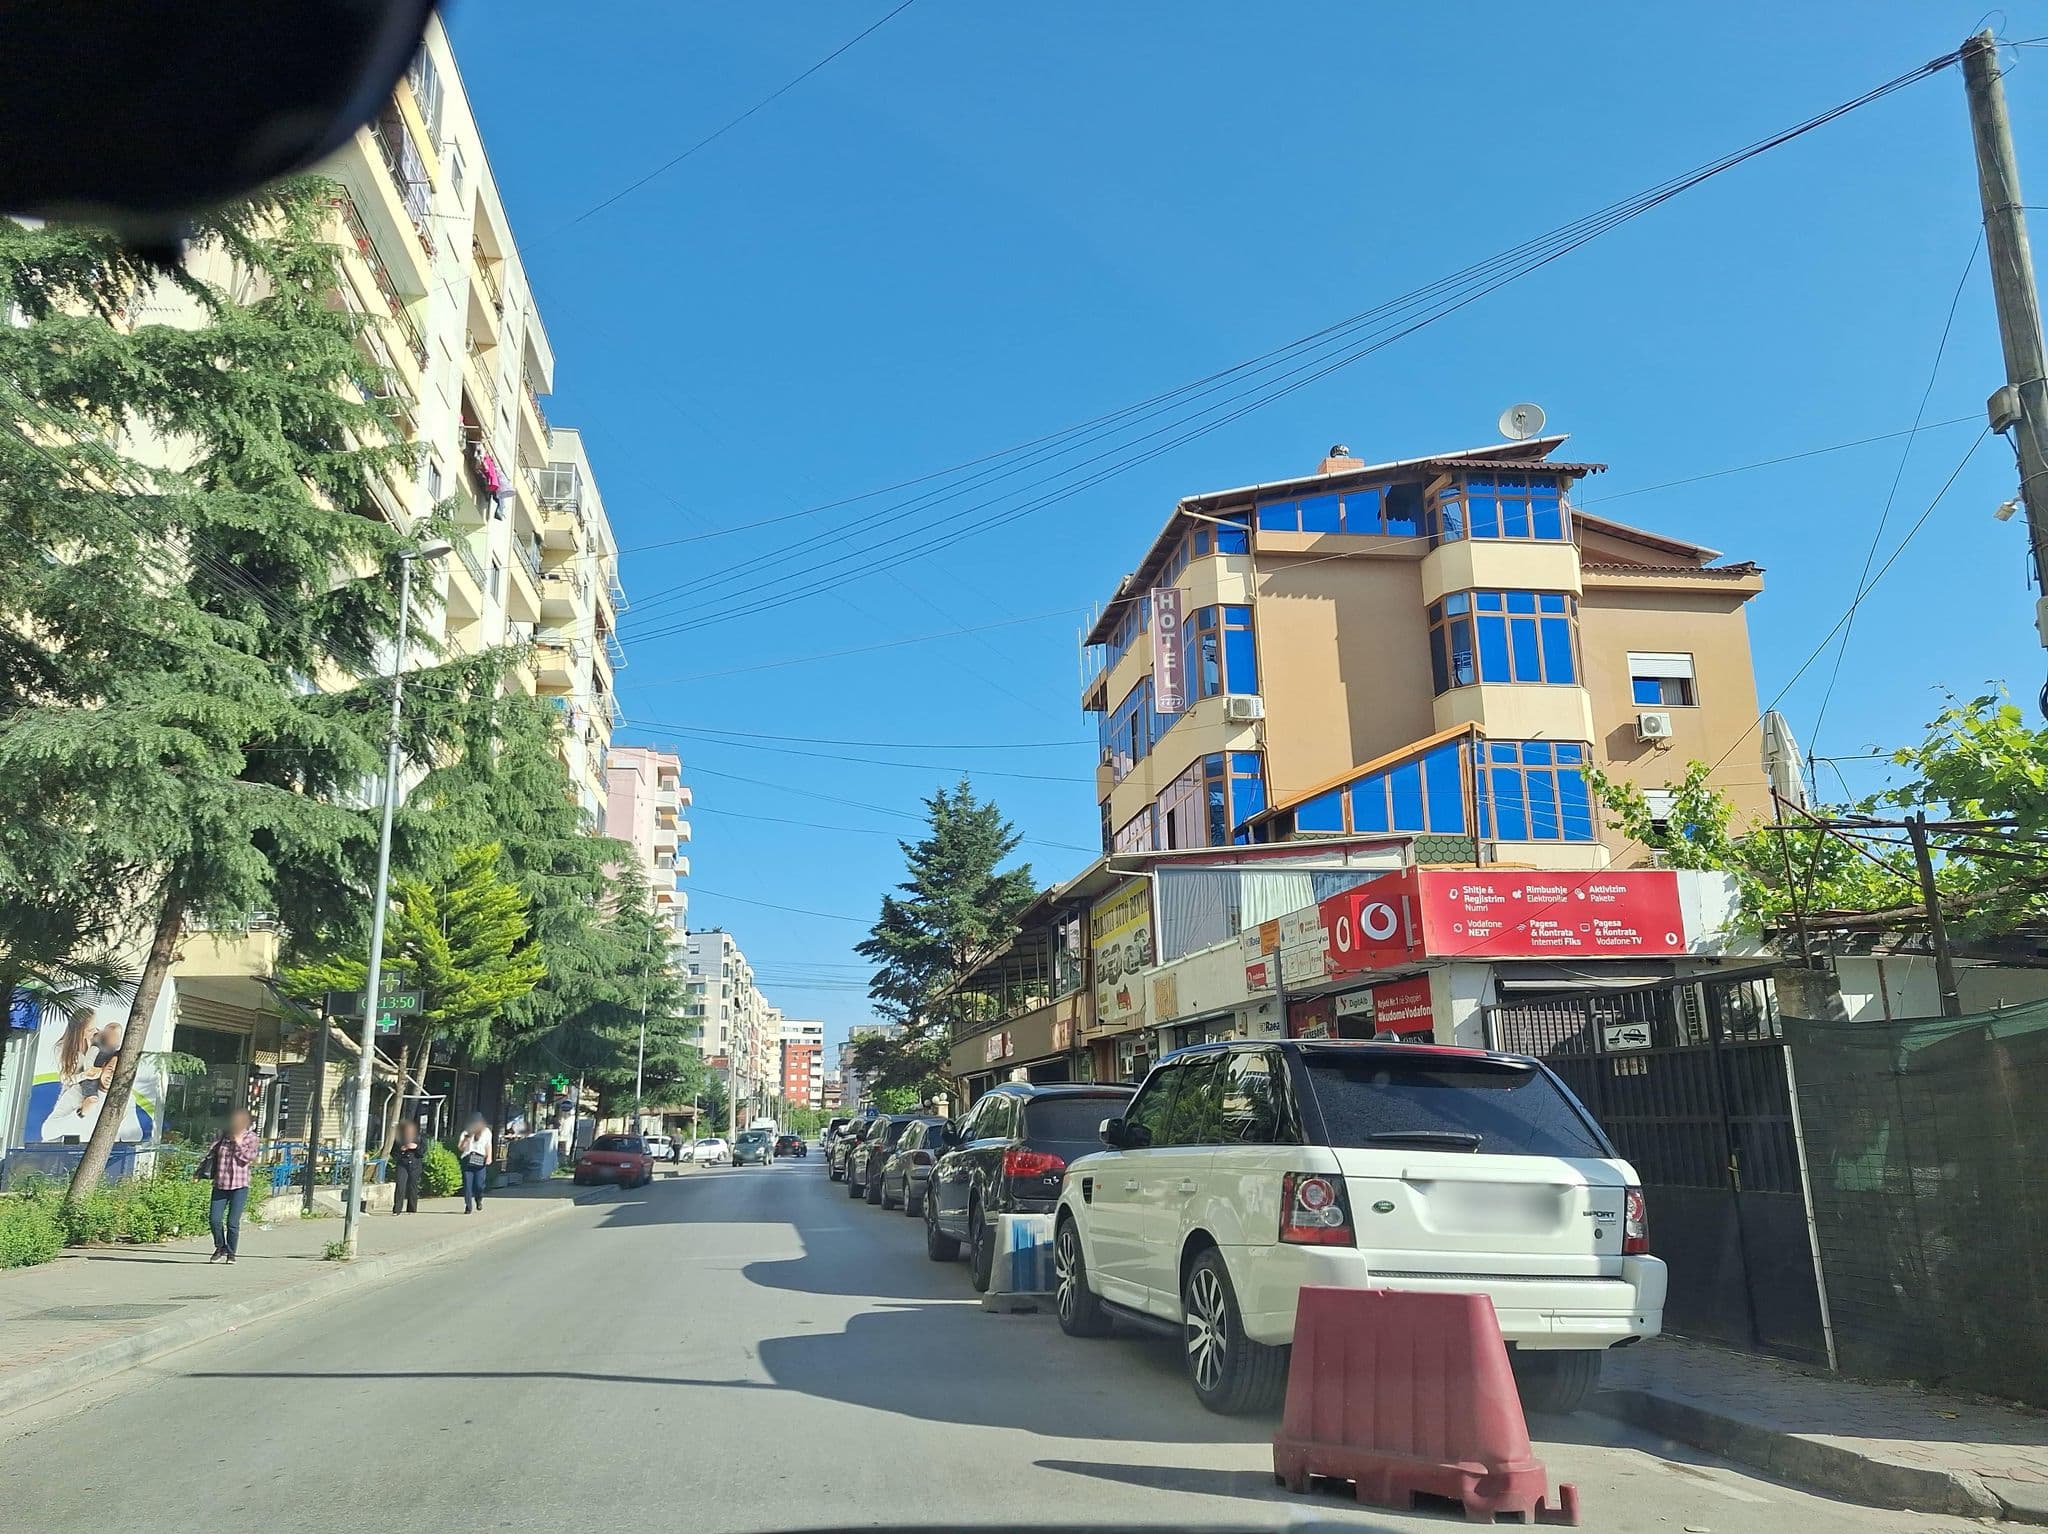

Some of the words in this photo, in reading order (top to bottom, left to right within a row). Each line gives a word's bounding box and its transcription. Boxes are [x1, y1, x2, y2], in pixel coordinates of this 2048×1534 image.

[1160, 593, 1176, 689] HOTEL
[1462, 885, 1485, 896] Shitje
[1487, 885, 1494, 894] &
[1525, 885, 1568, 895] Rimbushje
[1588, 884, 1627, 893] Aktivizim
[1464, 895, 1505, 905] Regjistrim
[1527, 894, 1569, 903] Elektronike
[1590, 894, 1616, 902] Pakete
[1465, 904, 1489, 912] Numri
[1467, 919, 1504, 928] Vodafone
[1529, 919, 1558, 930] Pagesa
[1593, 918, 1622, 929] Pagesa
[1468, 928, 1490, 937] NEXT
[1531, 928, 1538, 937] &
[1539, 928, 1574, 937] Kontrata
[1595, 928, 1602, 936] &
[1603, 927, 1637, 936] Kontrata
[1531, 937, 1563, 946] Interneti
[1564, 937, 1582, 946] Fiks
[1596, 937, 1631, 945] Vodafone
[1631, 936, 1643, 945] TV
[1582, 1210, 1616, 1218] SPORT
